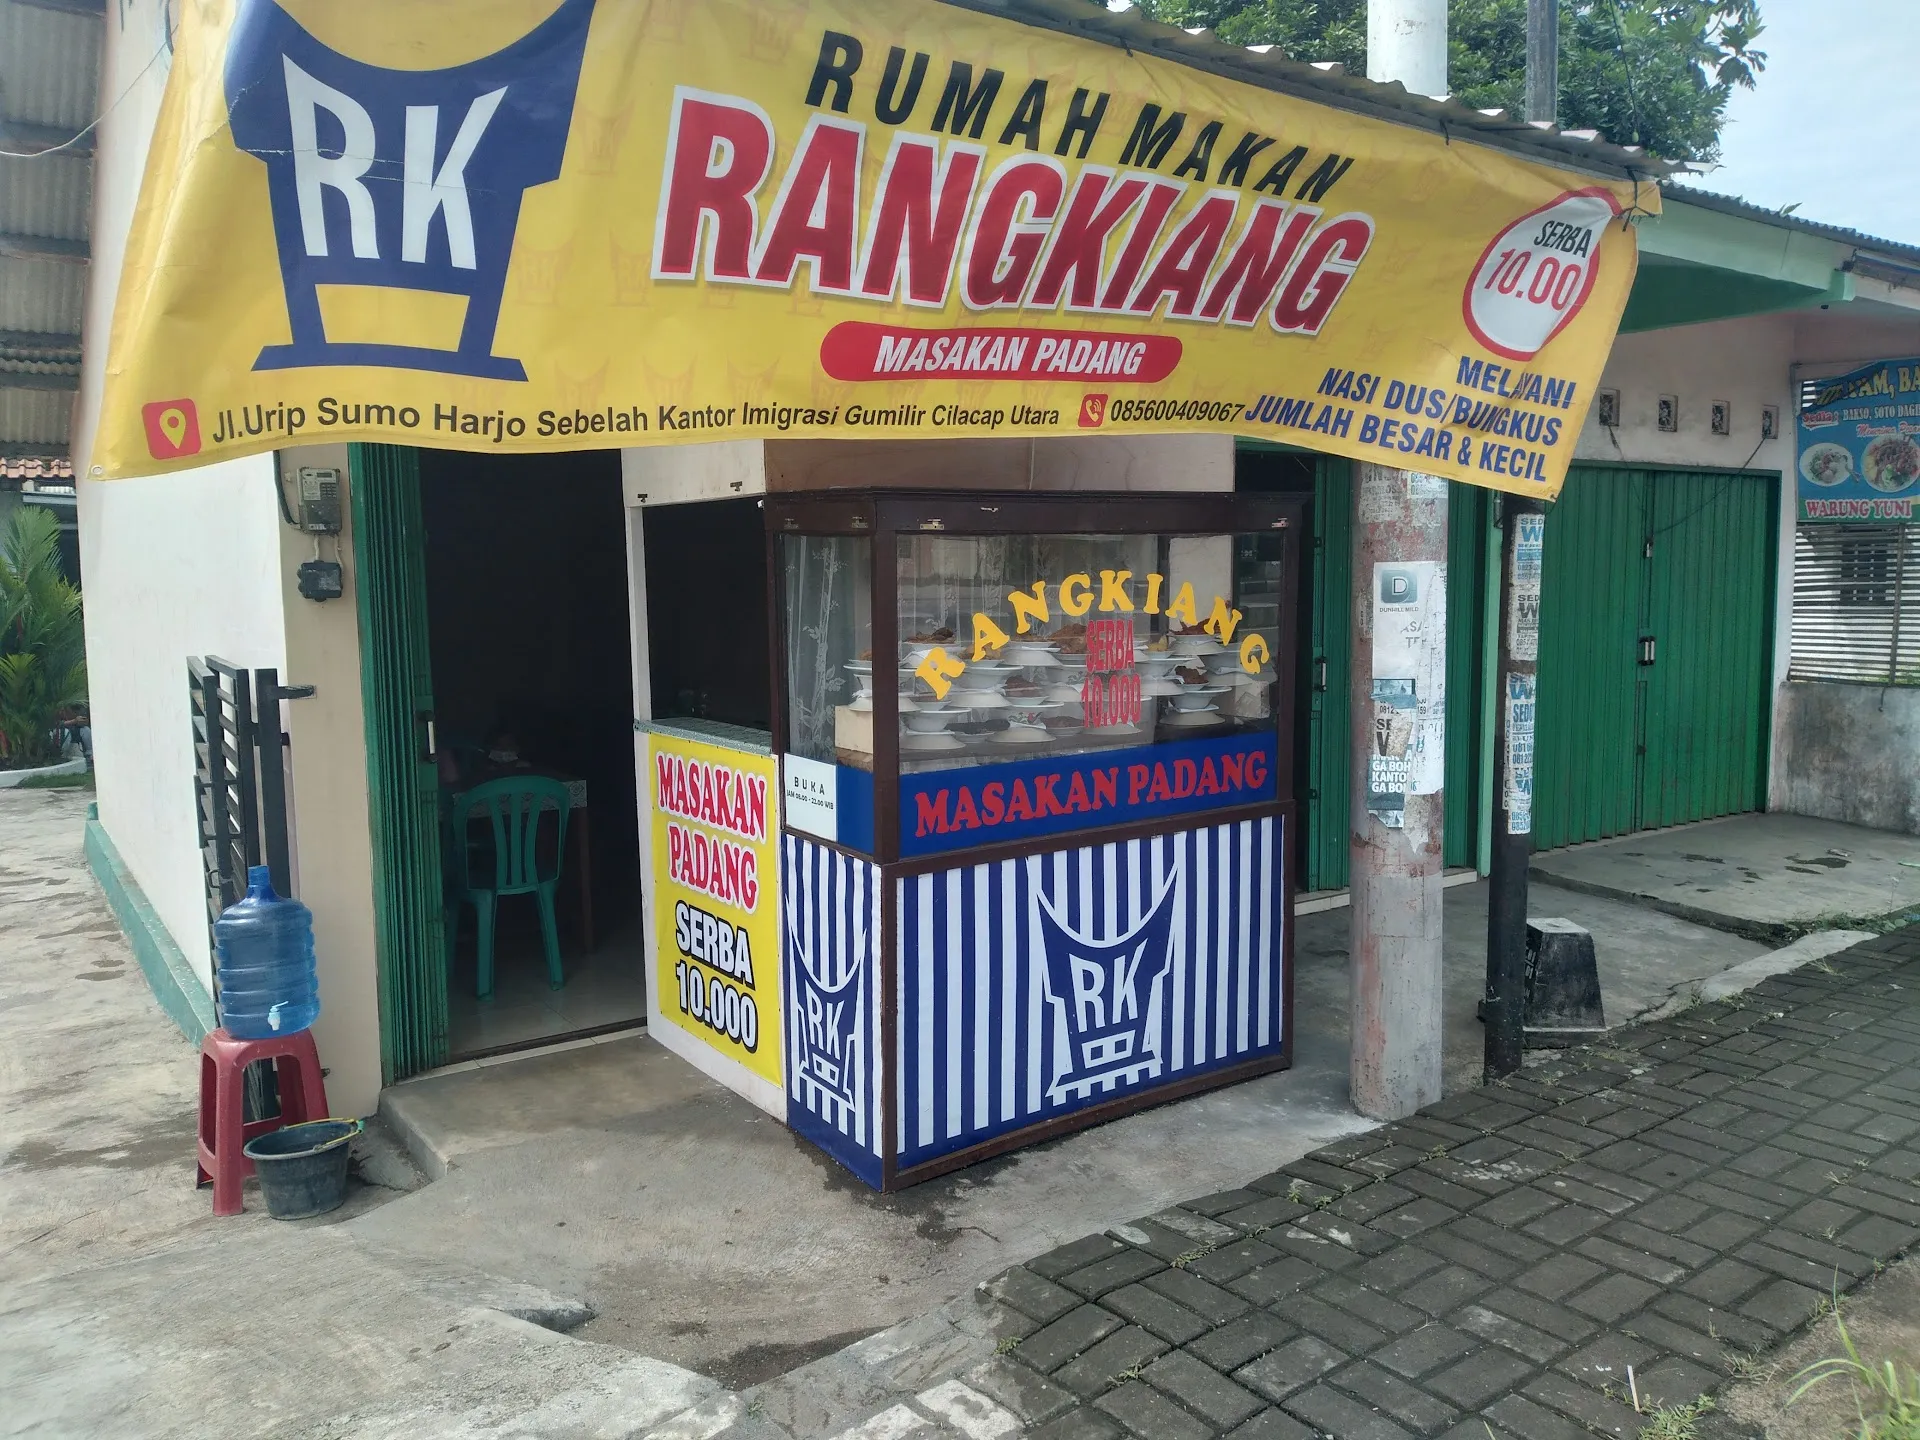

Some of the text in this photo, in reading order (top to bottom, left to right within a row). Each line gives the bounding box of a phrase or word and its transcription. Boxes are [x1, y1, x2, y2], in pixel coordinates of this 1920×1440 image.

[805, 30, 1354, 203] RUMAH MAKAN
[282, 53, 508, 270] RK
[650, 85, 1376, 336] RANGKIANG
[1533, 220, 1593, 259] SERBA
[873, 335, 1149, 375] MASAKAN PADANG
[1457, 355, 1576, 410] MELAYANI
[212, 398, 1059, 443] Jl.Urip Sumo Harjo Sebelah Kantor Imigrasi Gumilir Cilacap Utara
[1110, 397, 1245, 424] 085600409067
[1317, 367, 1563, 447] NASI DUS/BUNGKUS
[1874, 405, 1896, 419] SOTO
[1245, 395, 1546, 483] JUMLAH BESAR & KECIL
[1806, 500, 1912, 518] WARUNG YUNI
[1392, 577, 1408, 594] D
[915, 570, 1270, 700] RANGKIANG
[1085, 619, 1136, 673] SERBA
[1081, 673, 1142, 728] 10.000
[794, 776, 825, 796] BUKA
[1371, 782, 1387, 793] GA
[1372, 760, 1387, 771] GA
[1372, 771, 1408, 782] KANTO
[657, 751, 767, 843] MASAKAN
[914, 750, 1268, 838] MASAKAN PADANG
[668, 823, 760, 914] PADANG
[675, 900, 755, 990] SERBA
[676, 960, 758, 1054] 10.000
[1068, 938, 1148, 1033] RK
[804, 978, 845, 1061] RK
